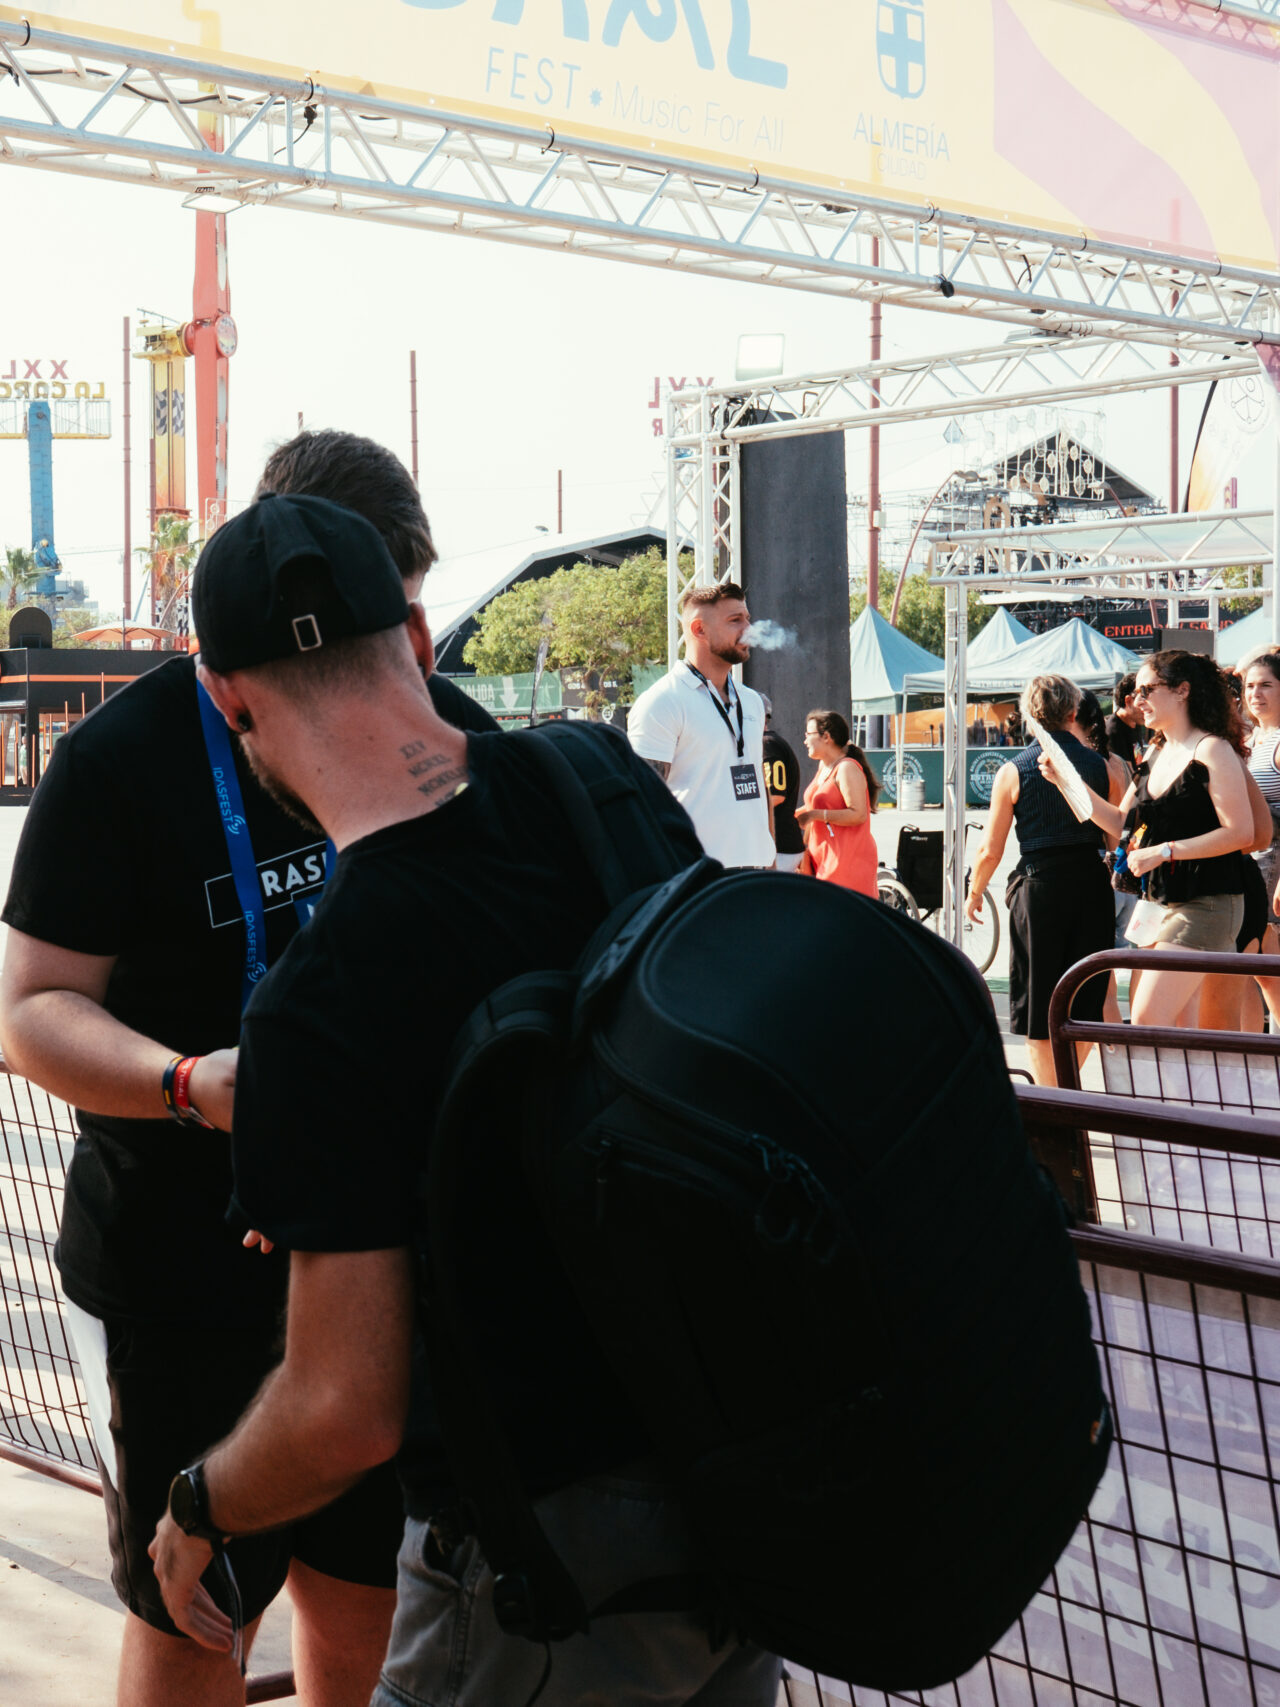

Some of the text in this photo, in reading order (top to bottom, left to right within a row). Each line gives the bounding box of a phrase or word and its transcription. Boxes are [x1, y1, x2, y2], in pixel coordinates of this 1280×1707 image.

[485, 46, 785, 153] FEST Music For All
[853, 111, 951, 162] ALMERÍA
[876, 152, 927, 181] CIUDAD
[1104, 621, 1170, 638] ENTRA
[212, 767, 233, 823] IDASFEST
[736, 782, 757, 795] STAFF
[261, 851, 327, 897] RAS
[245, 910, 257, 969] IDASFEST
